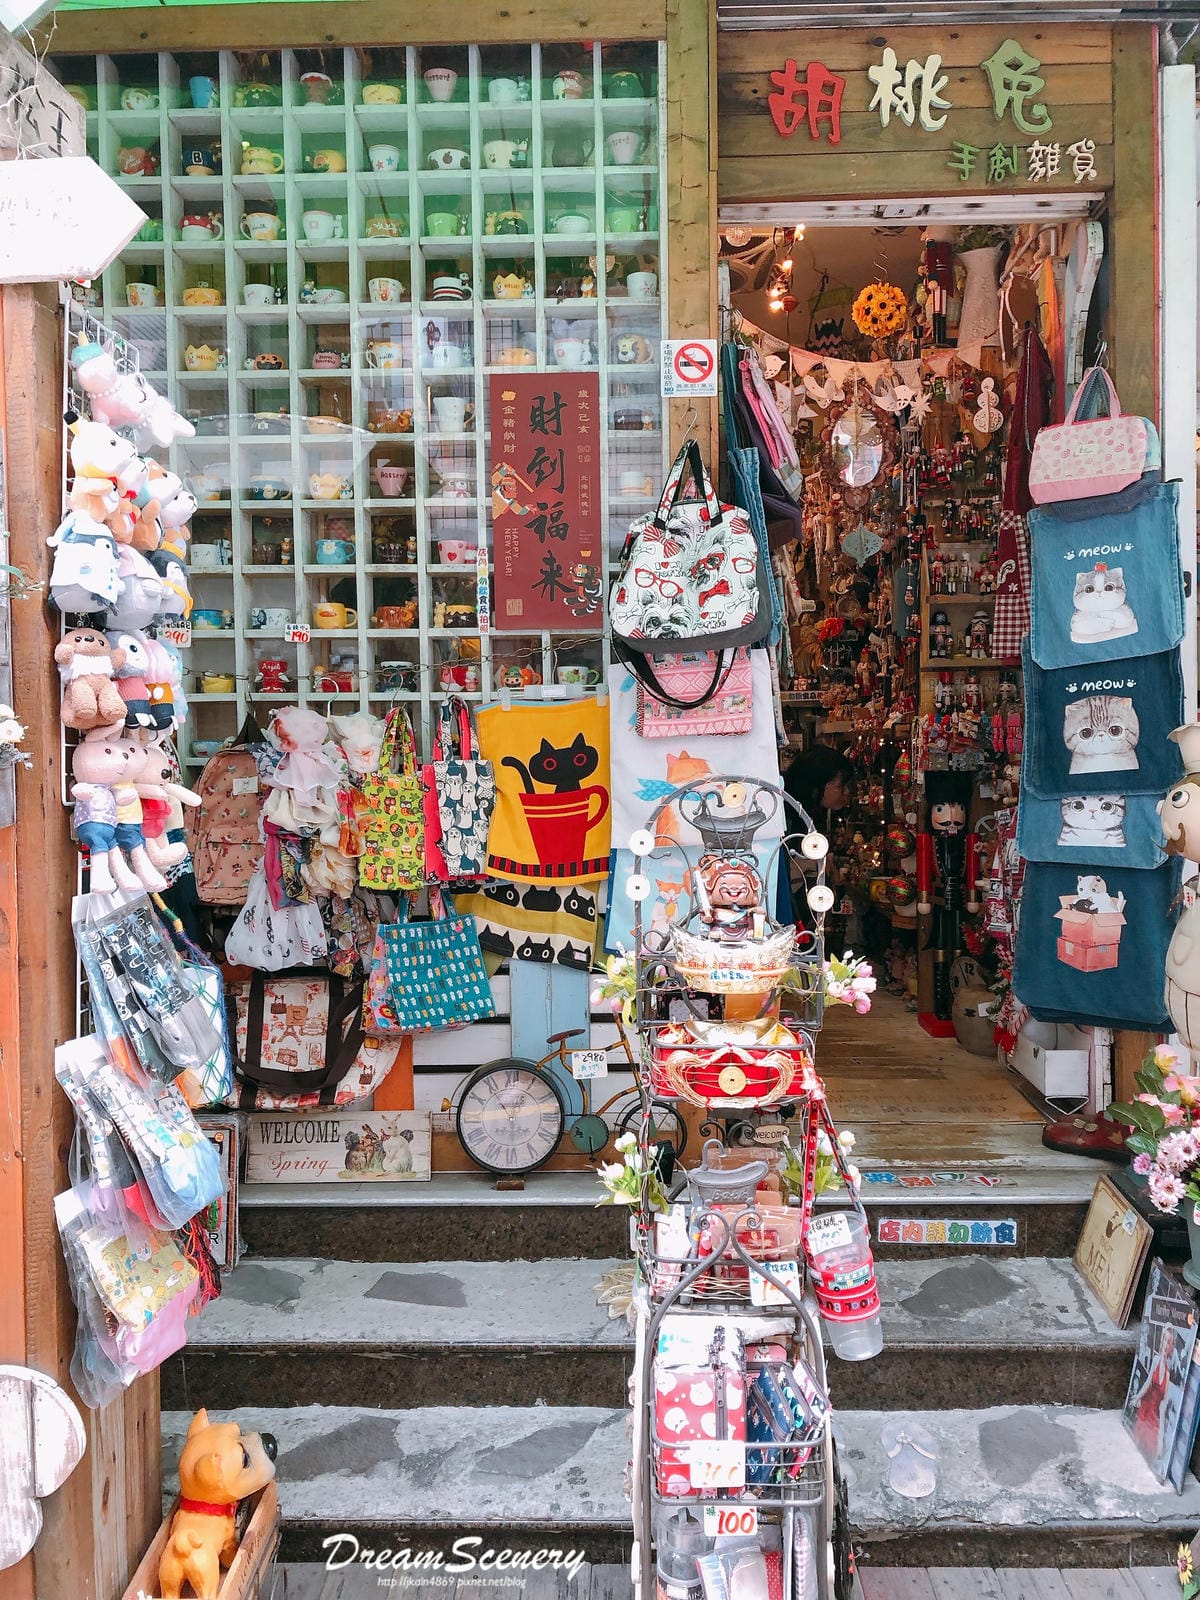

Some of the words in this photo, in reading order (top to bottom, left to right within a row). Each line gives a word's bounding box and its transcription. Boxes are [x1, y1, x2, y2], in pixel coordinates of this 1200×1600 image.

[947, 138, 1098, 185] 手創雜貨
[577, 389, 591, 434] 歲次己亥
[502, 405, 517, 454] 金豬納財
[511, 527, 520, 560] HAPPY
[1078, 543, 1123, 559] meow
[291, 630, 309, 643] 190
[1081, 679, 1125, 692] meow
[581, 1052, 605, 1063] 2980
[260, 1120, 341, 1145] WELCOME
[270, 1151, 329, 1178] Spring
[879, 1219, 1016, 1244] 店內請勿飲食
[1086, 1243, 1116, 1290] MEN
[717, 1509, 756, 1535] 100
